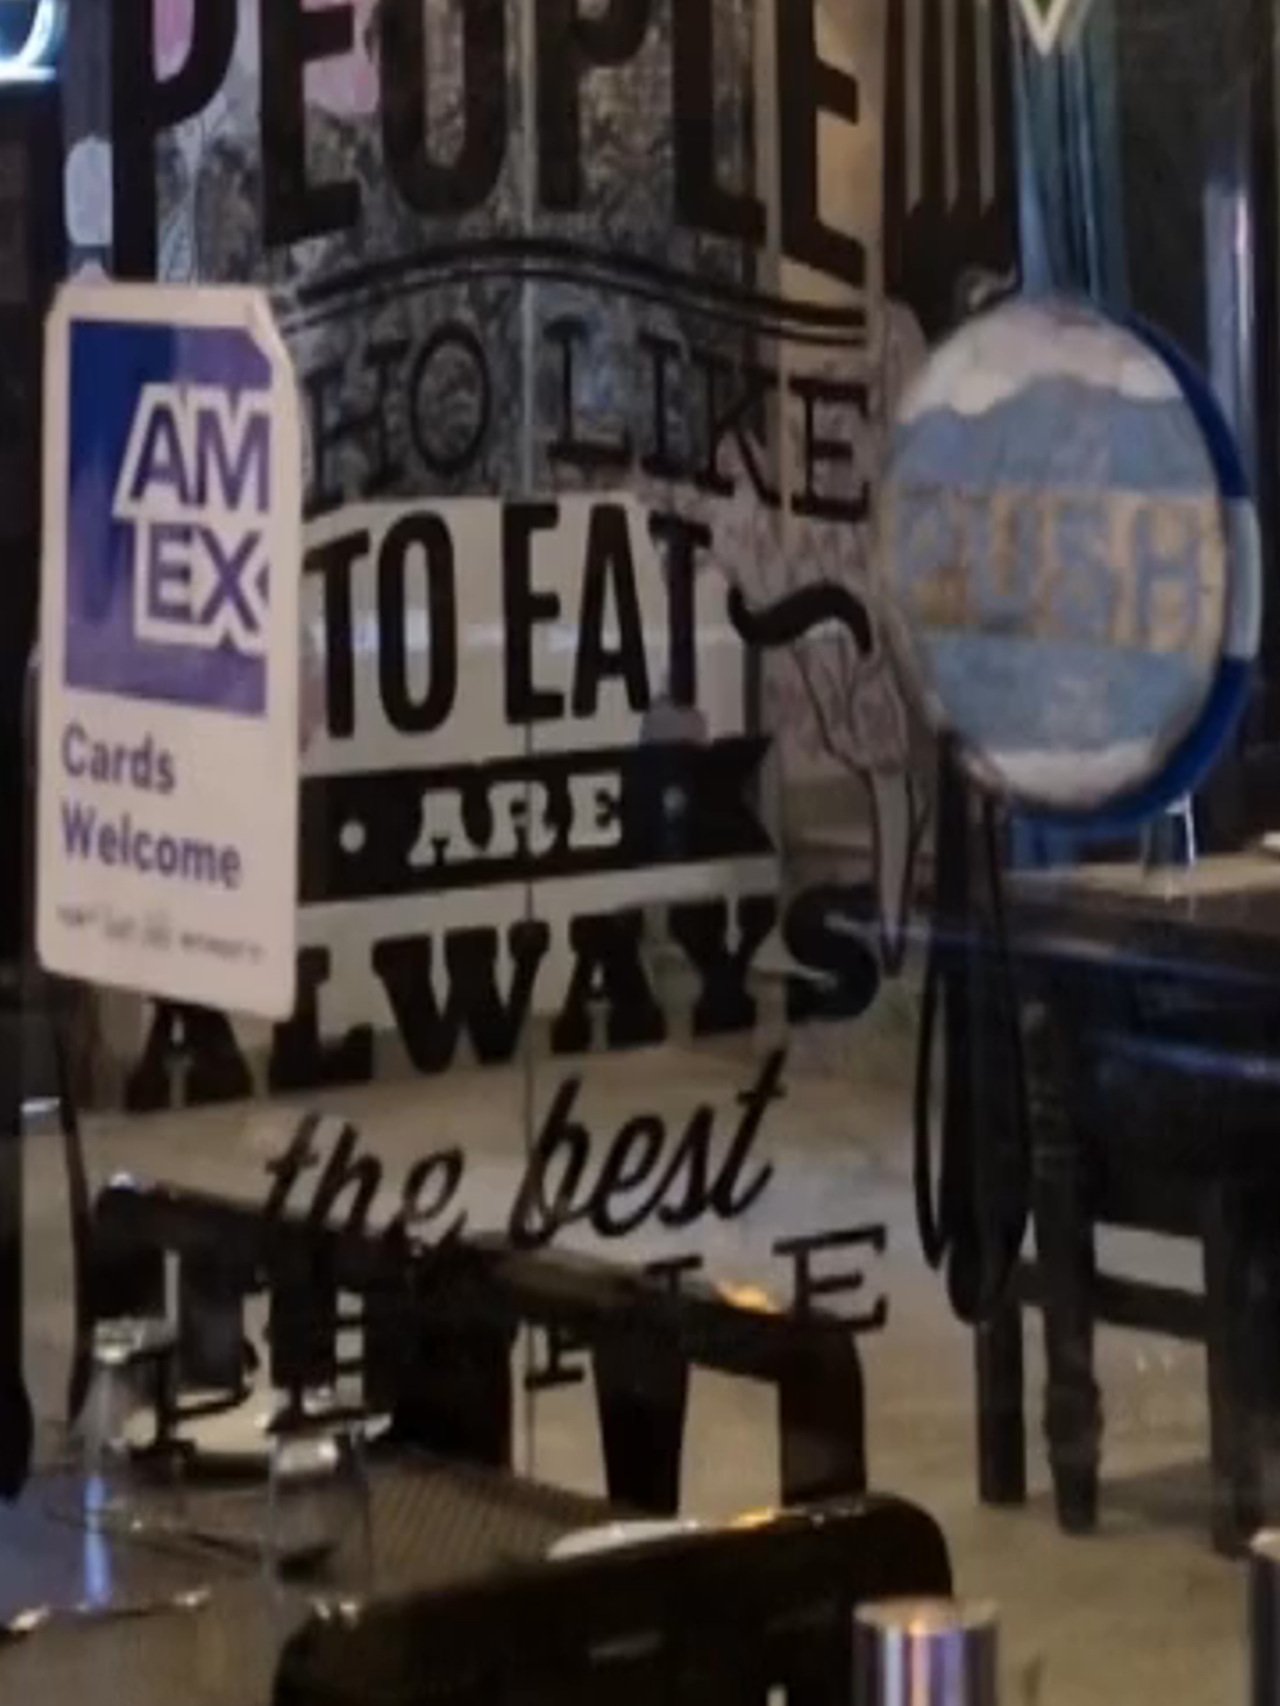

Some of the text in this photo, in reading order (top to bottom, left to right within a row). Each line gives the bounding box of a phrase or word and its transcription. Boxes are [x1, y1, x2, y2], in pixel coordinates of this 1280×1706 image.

[303, 313, 871, 523] HO LIKE
[303, 501, 713, 739] TO EAT
[60, 799, 244, 890] Welcome
[61, 722, 177, 794] Cards
[407, 774, 624, 869] ARE
[125, 881, 882, 1113] ALWAYS
[265, 1047, 789, 1258] the best
